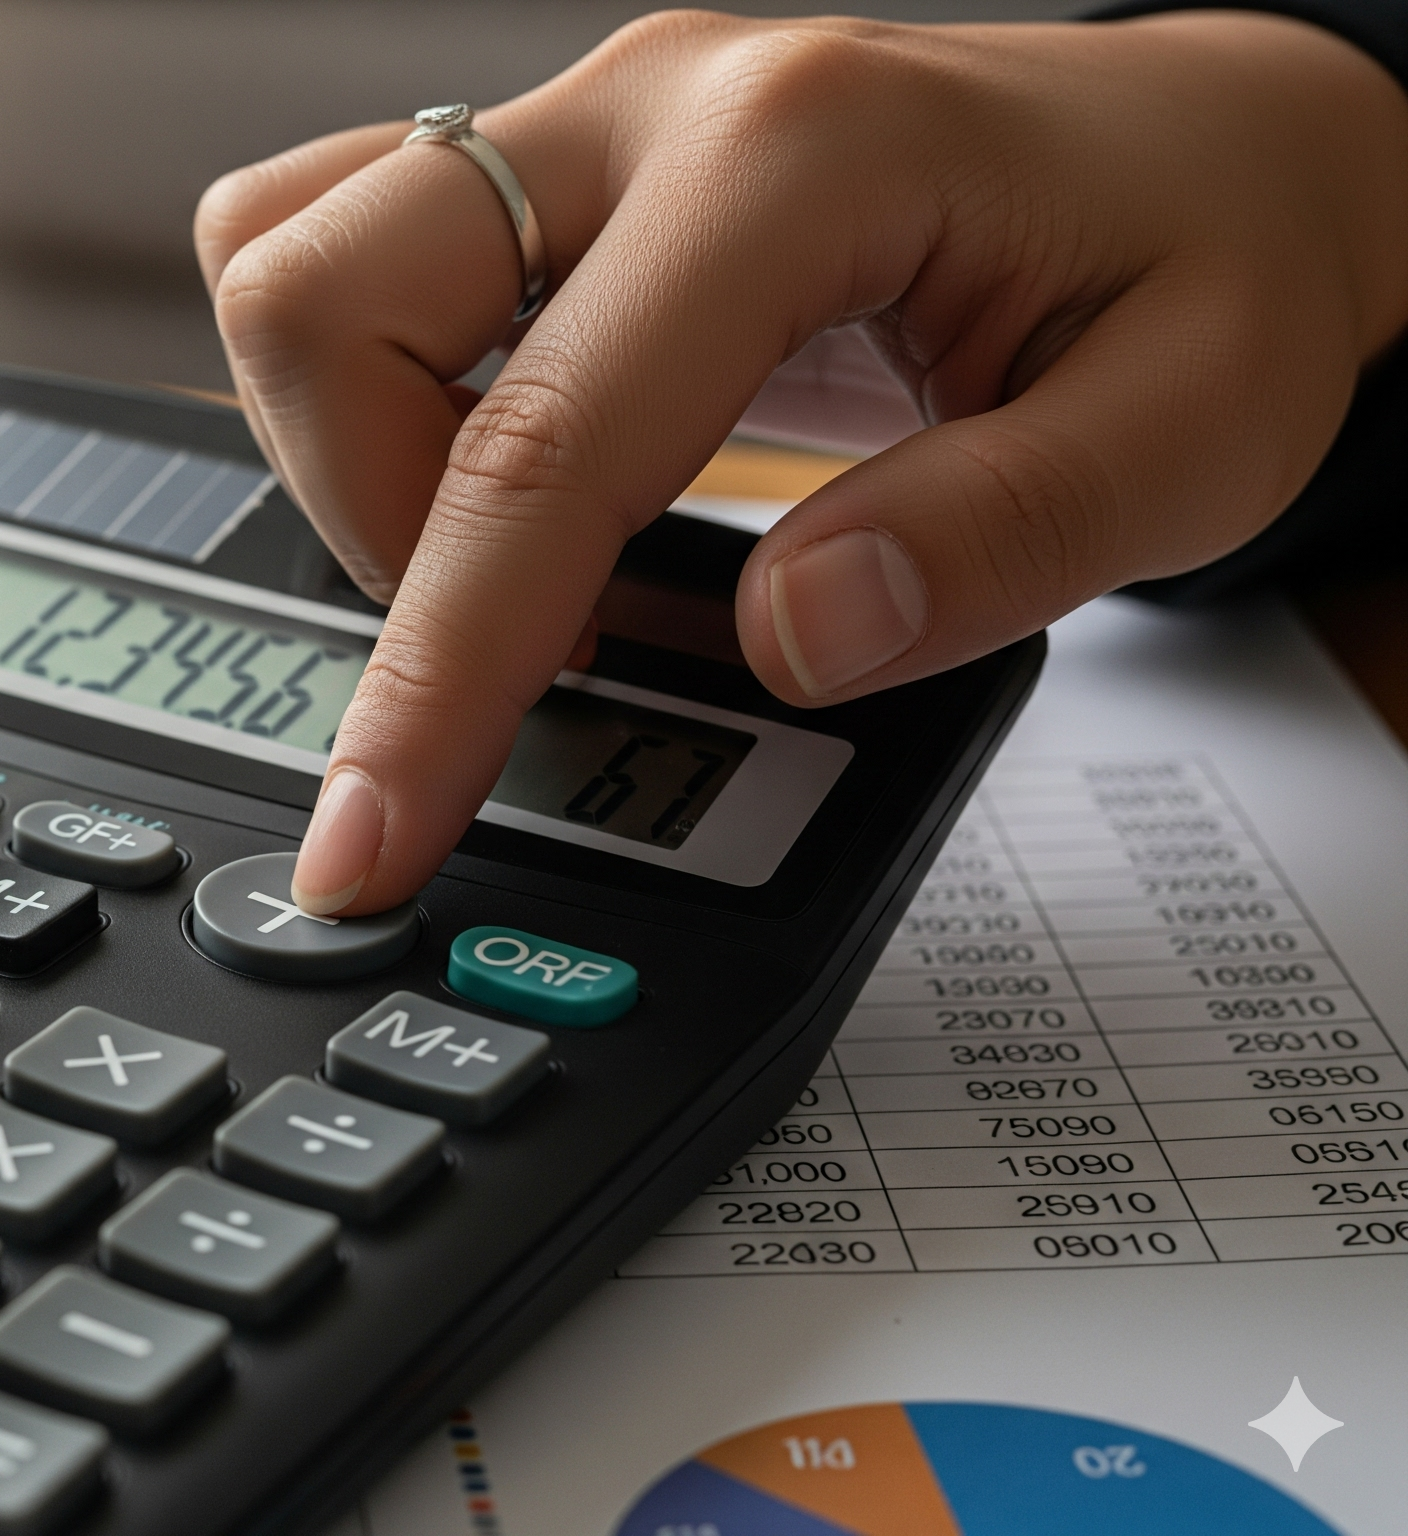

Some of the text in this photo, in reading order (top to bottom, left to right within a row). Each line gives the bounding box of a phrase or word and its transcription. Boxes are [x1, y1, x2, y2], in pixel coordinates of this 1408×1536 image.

[364, 1010, 499, 1067] M+
[979, 1115, 1116, 1138] 75090
[1291, 1139, 1408, 1164] 0551
[997, 1153, 1134, 1177] 15090
[718, 1200, 861, 1224] 22820
